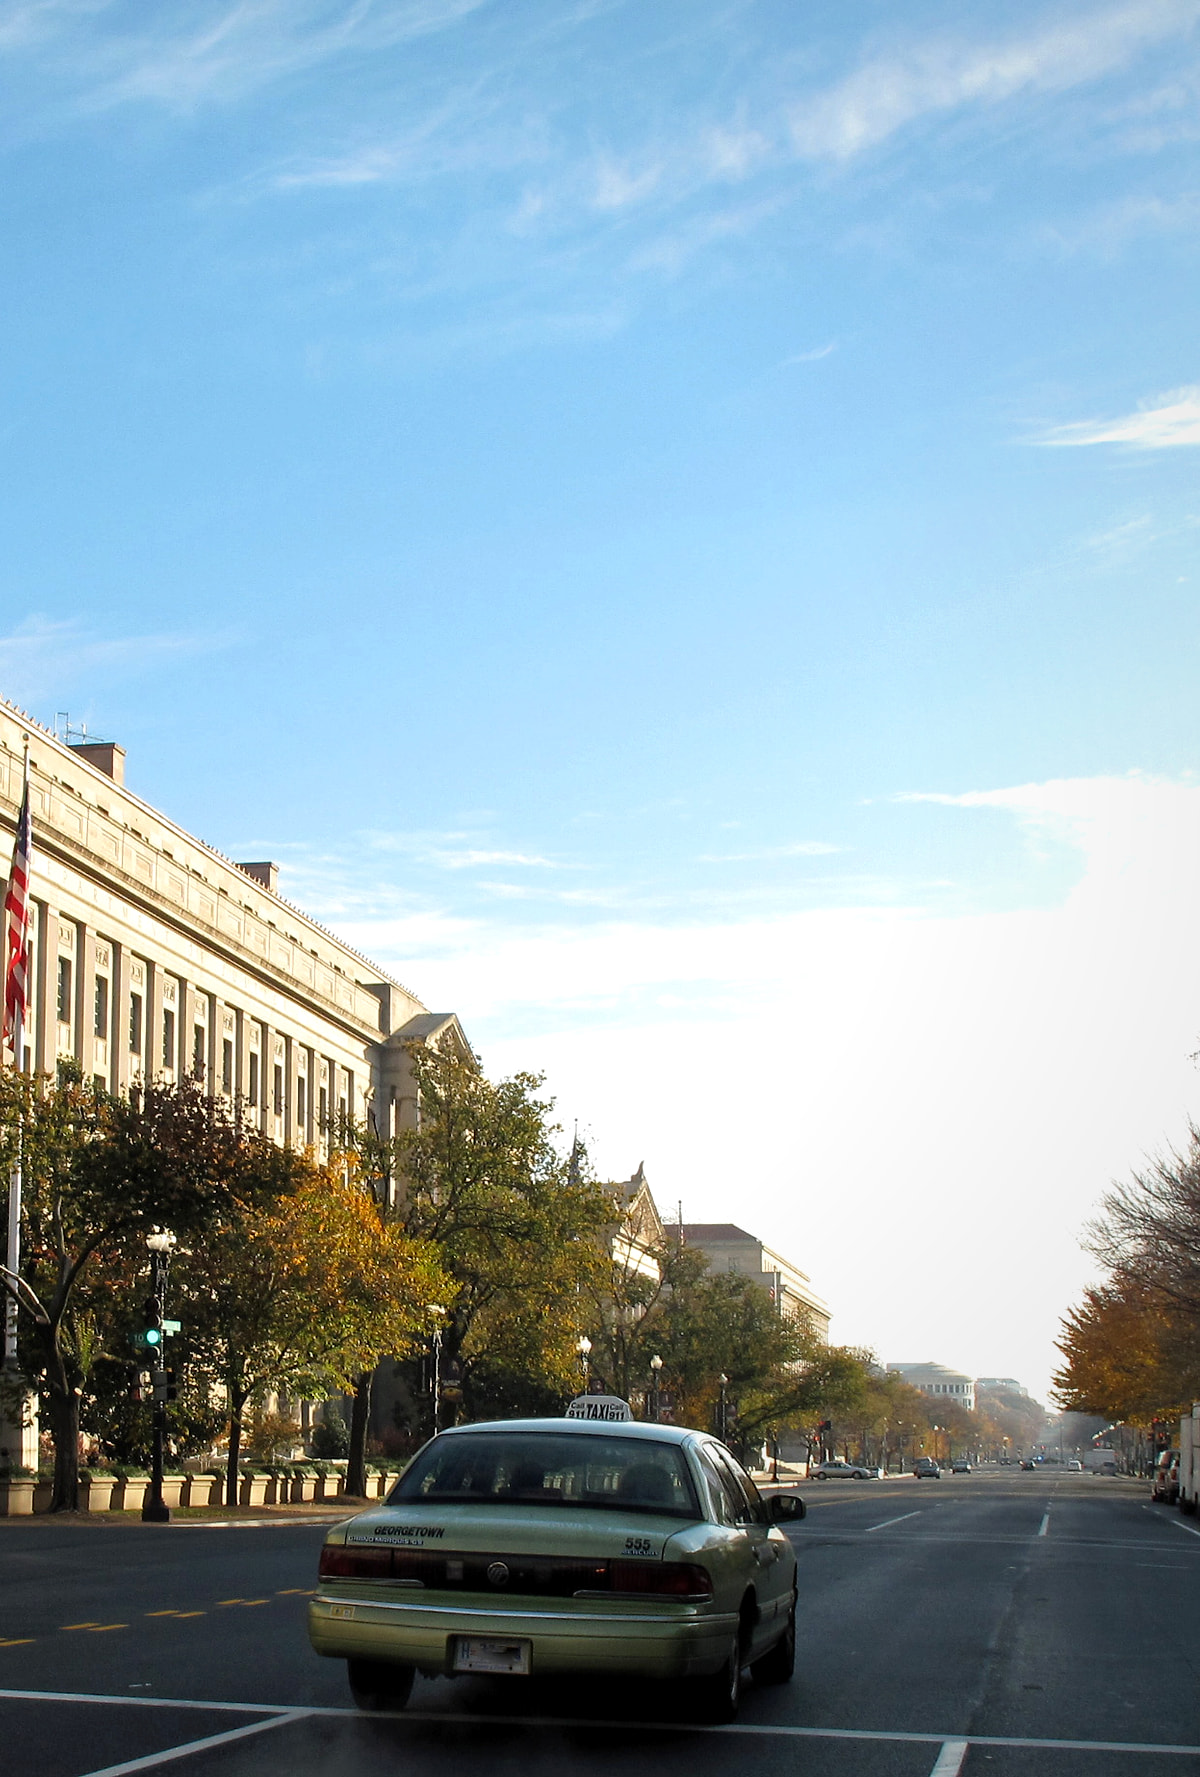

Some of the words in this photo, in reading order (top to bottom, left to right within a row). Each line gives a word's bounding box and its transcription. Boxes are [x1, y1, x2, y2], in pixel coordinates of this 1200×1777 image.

[568, 1410, 585, 1418] 911
[586, 1403, 610, 1420] TAXI
[609, 1411, 624, 1420] 911
[374, 1525, 446, 1538] GEORGETOWN
[624, 1537, 651, 1551] 555
